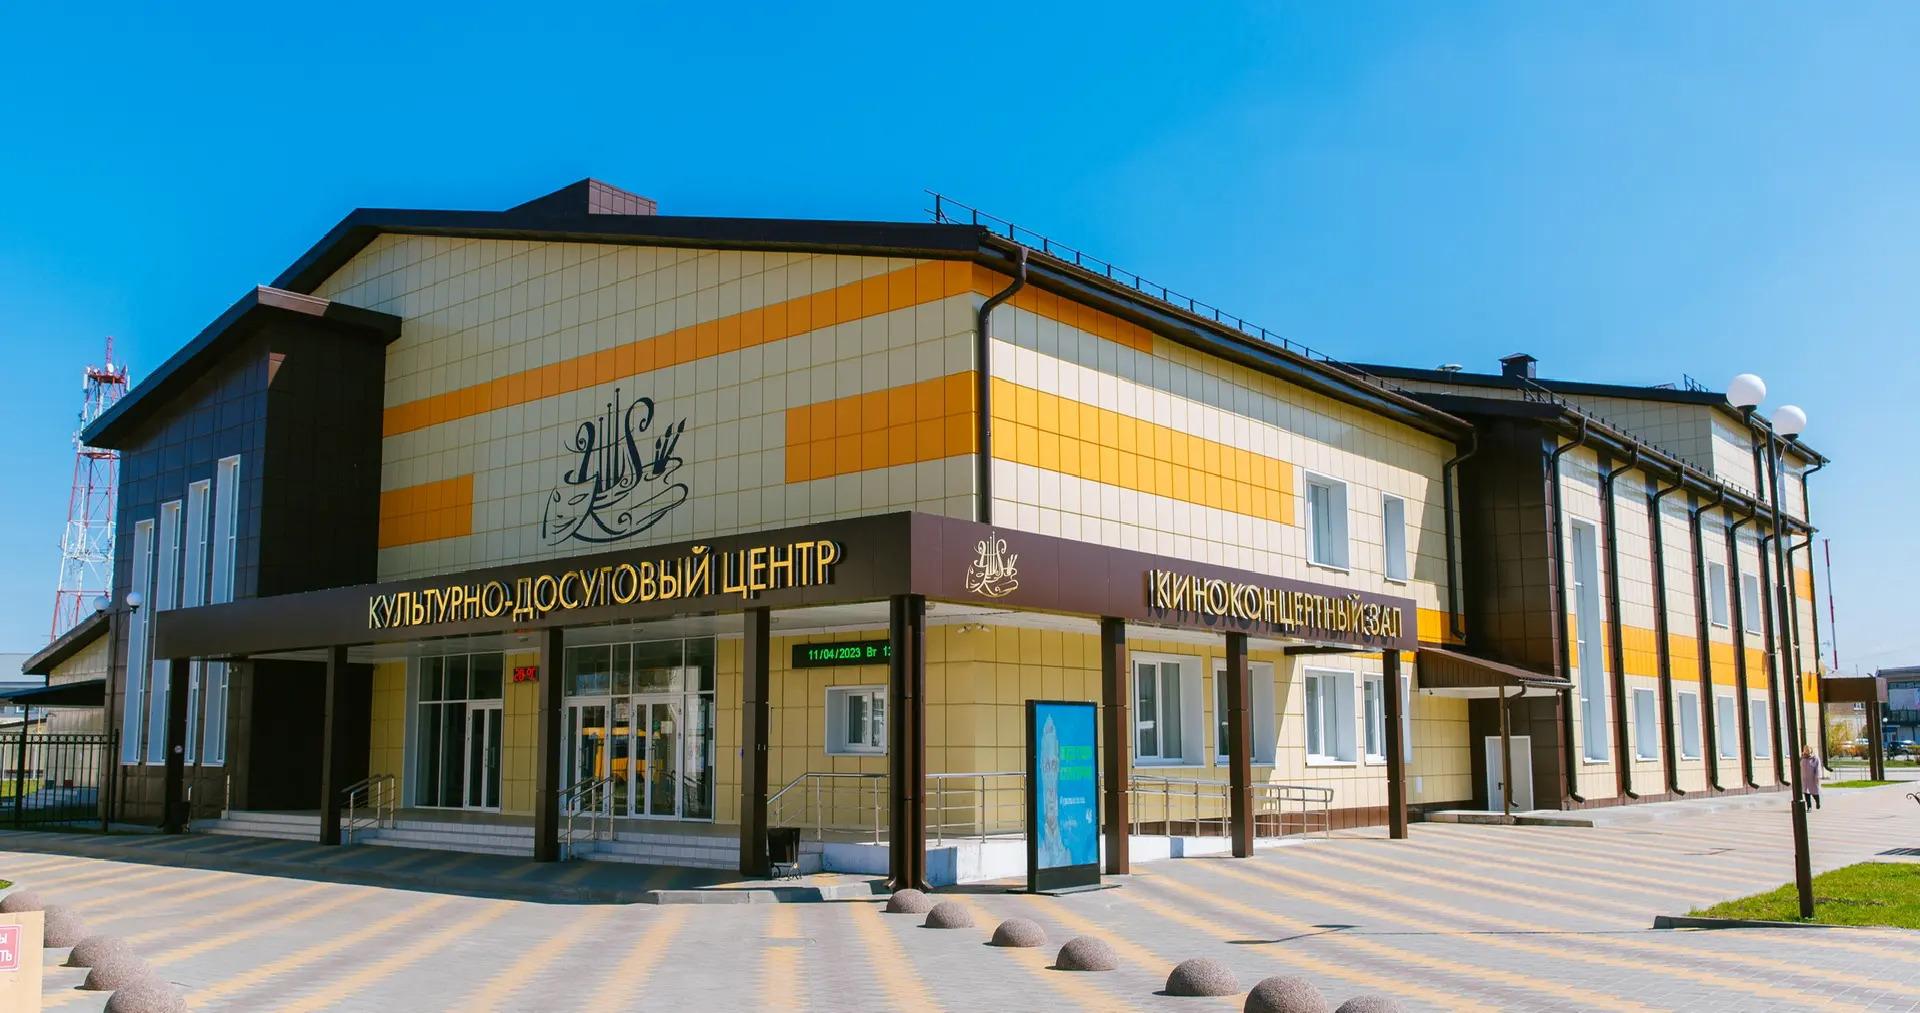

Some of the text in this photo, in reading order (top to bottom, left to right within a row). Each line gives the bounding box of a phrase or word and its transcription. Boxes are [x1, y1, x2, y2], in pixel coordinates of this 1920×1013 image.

[369, 540, 838, 629] КУЛЬТУРНО-ДОСУГОВЫЙ ЦЕНТР
[1154, 568, 1402, 637] КИНОКОНЦЕРТНЫЙ ЗАЛ
[808, 647, 861, 660] 11/04/2023
[866, 647, 877, 657] Вт
